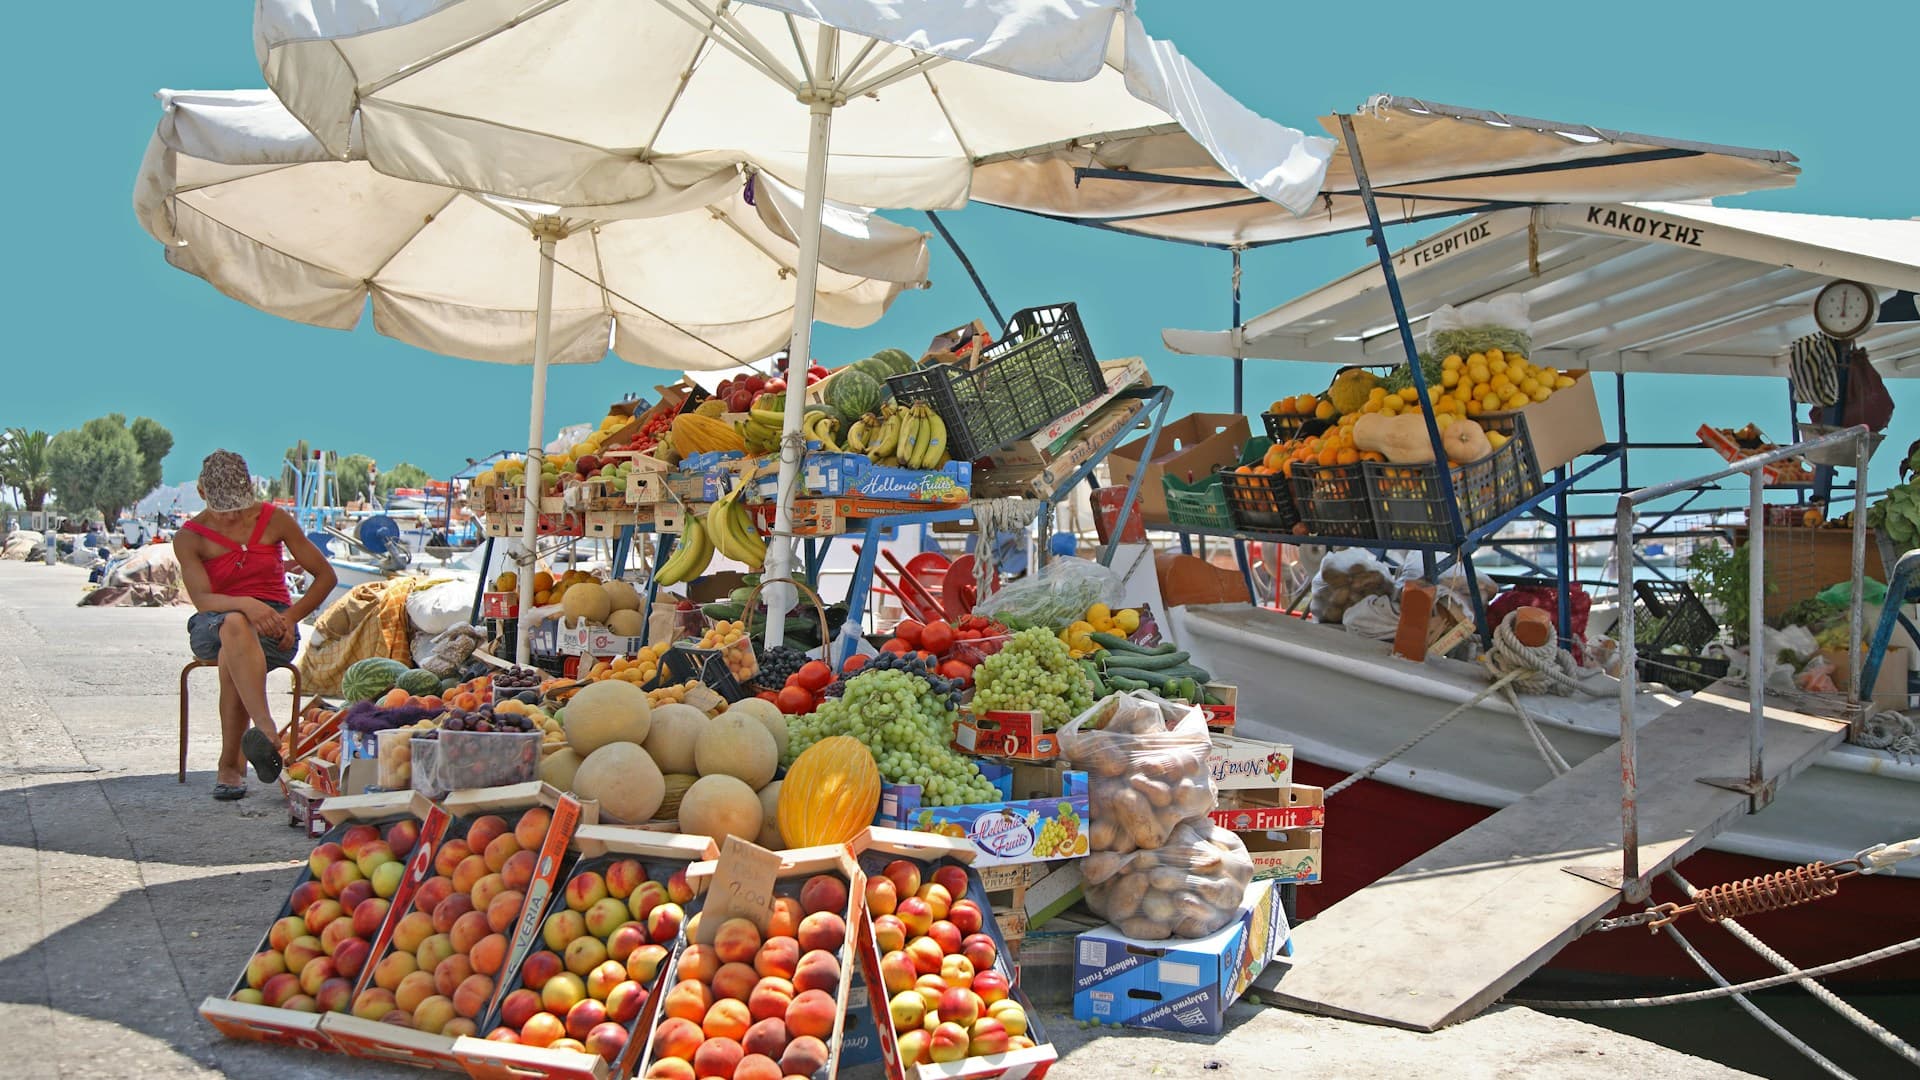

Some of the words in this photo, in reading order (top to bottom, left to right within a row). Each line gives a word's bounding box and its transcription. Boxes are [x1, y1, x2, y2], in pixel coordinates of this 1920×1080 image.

[1586, 205, 1705, 247] ΚΑΚΟΥΣΗΣ
[1413, 220, 1491, 267] ΓΕΩΡΓΙΟΣ
[1229, 759, 1264, 777] Nova
[967, 816, 1023, 840] Hellenic
[1256, 810, 1297, 829] Fruit
[991, 833, 1027, 857] Fruits
[1252, 857, 1282, 867] mega
[517, 896, 543, 949] VERIA
[1104, 956, 1138, 976] Hellenic
[1078, 971, 1103, 987] Fruits
